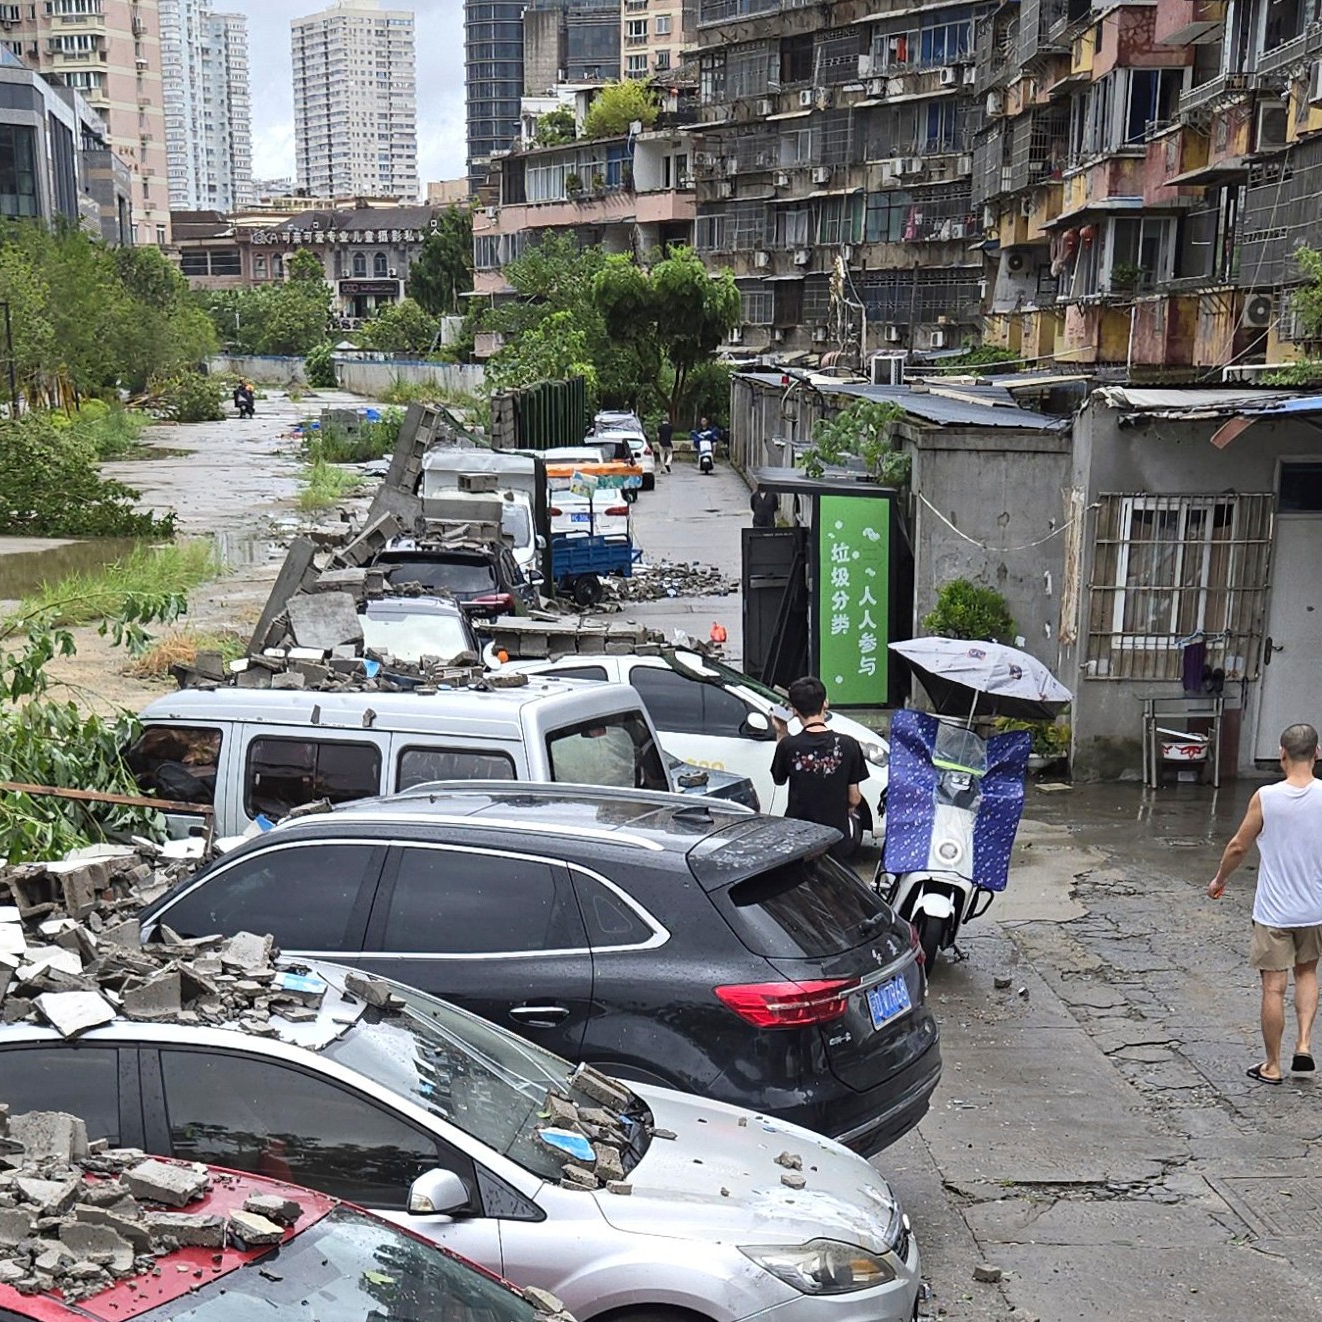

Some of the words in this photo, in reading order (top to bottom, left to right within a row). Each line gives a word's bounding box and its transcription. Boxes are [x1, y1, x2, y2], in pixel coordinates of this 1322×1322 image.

[830, 542, 850, 635] 垃圾分类
[858, 585, 877, 676] 人人参与
